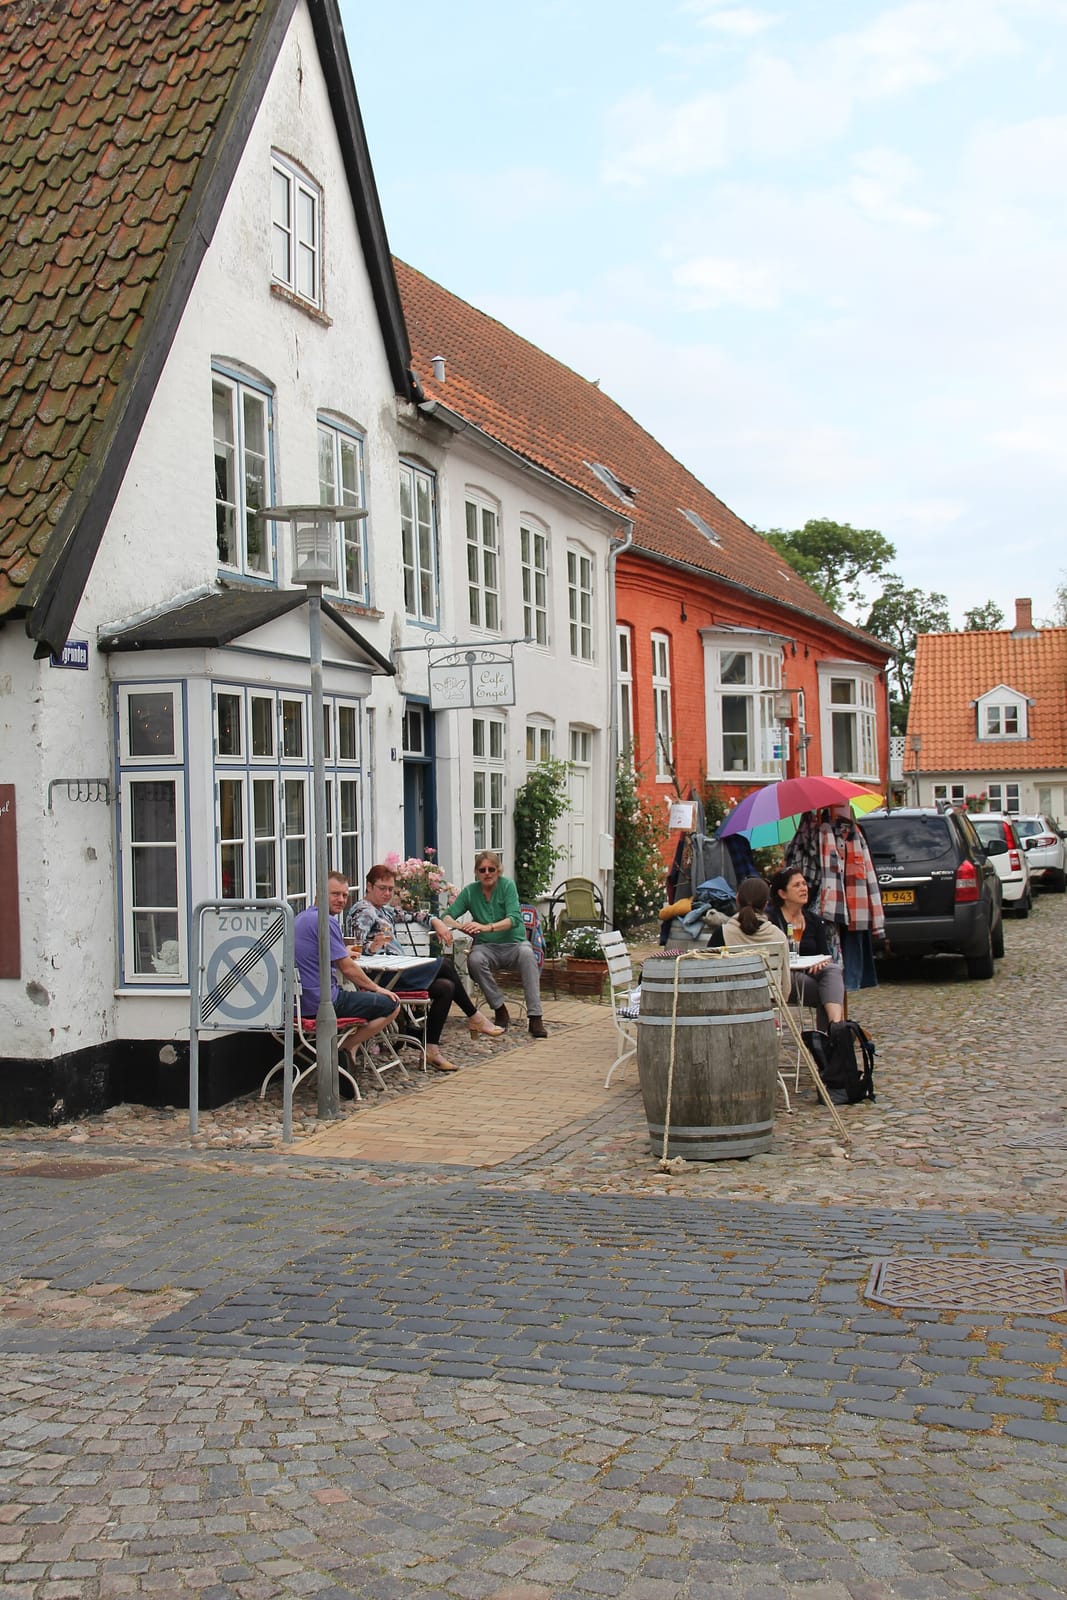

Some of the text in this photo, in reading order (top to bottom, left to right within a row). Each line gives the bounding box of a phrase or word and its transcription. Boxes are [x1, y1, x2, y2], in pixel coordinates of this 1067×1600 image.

[480, 670, 505, 688] Café
[476, 684, 509, 702] Engel
[892, 892, 912, 901] 943
[218, 916, 269, 931] ZONE
